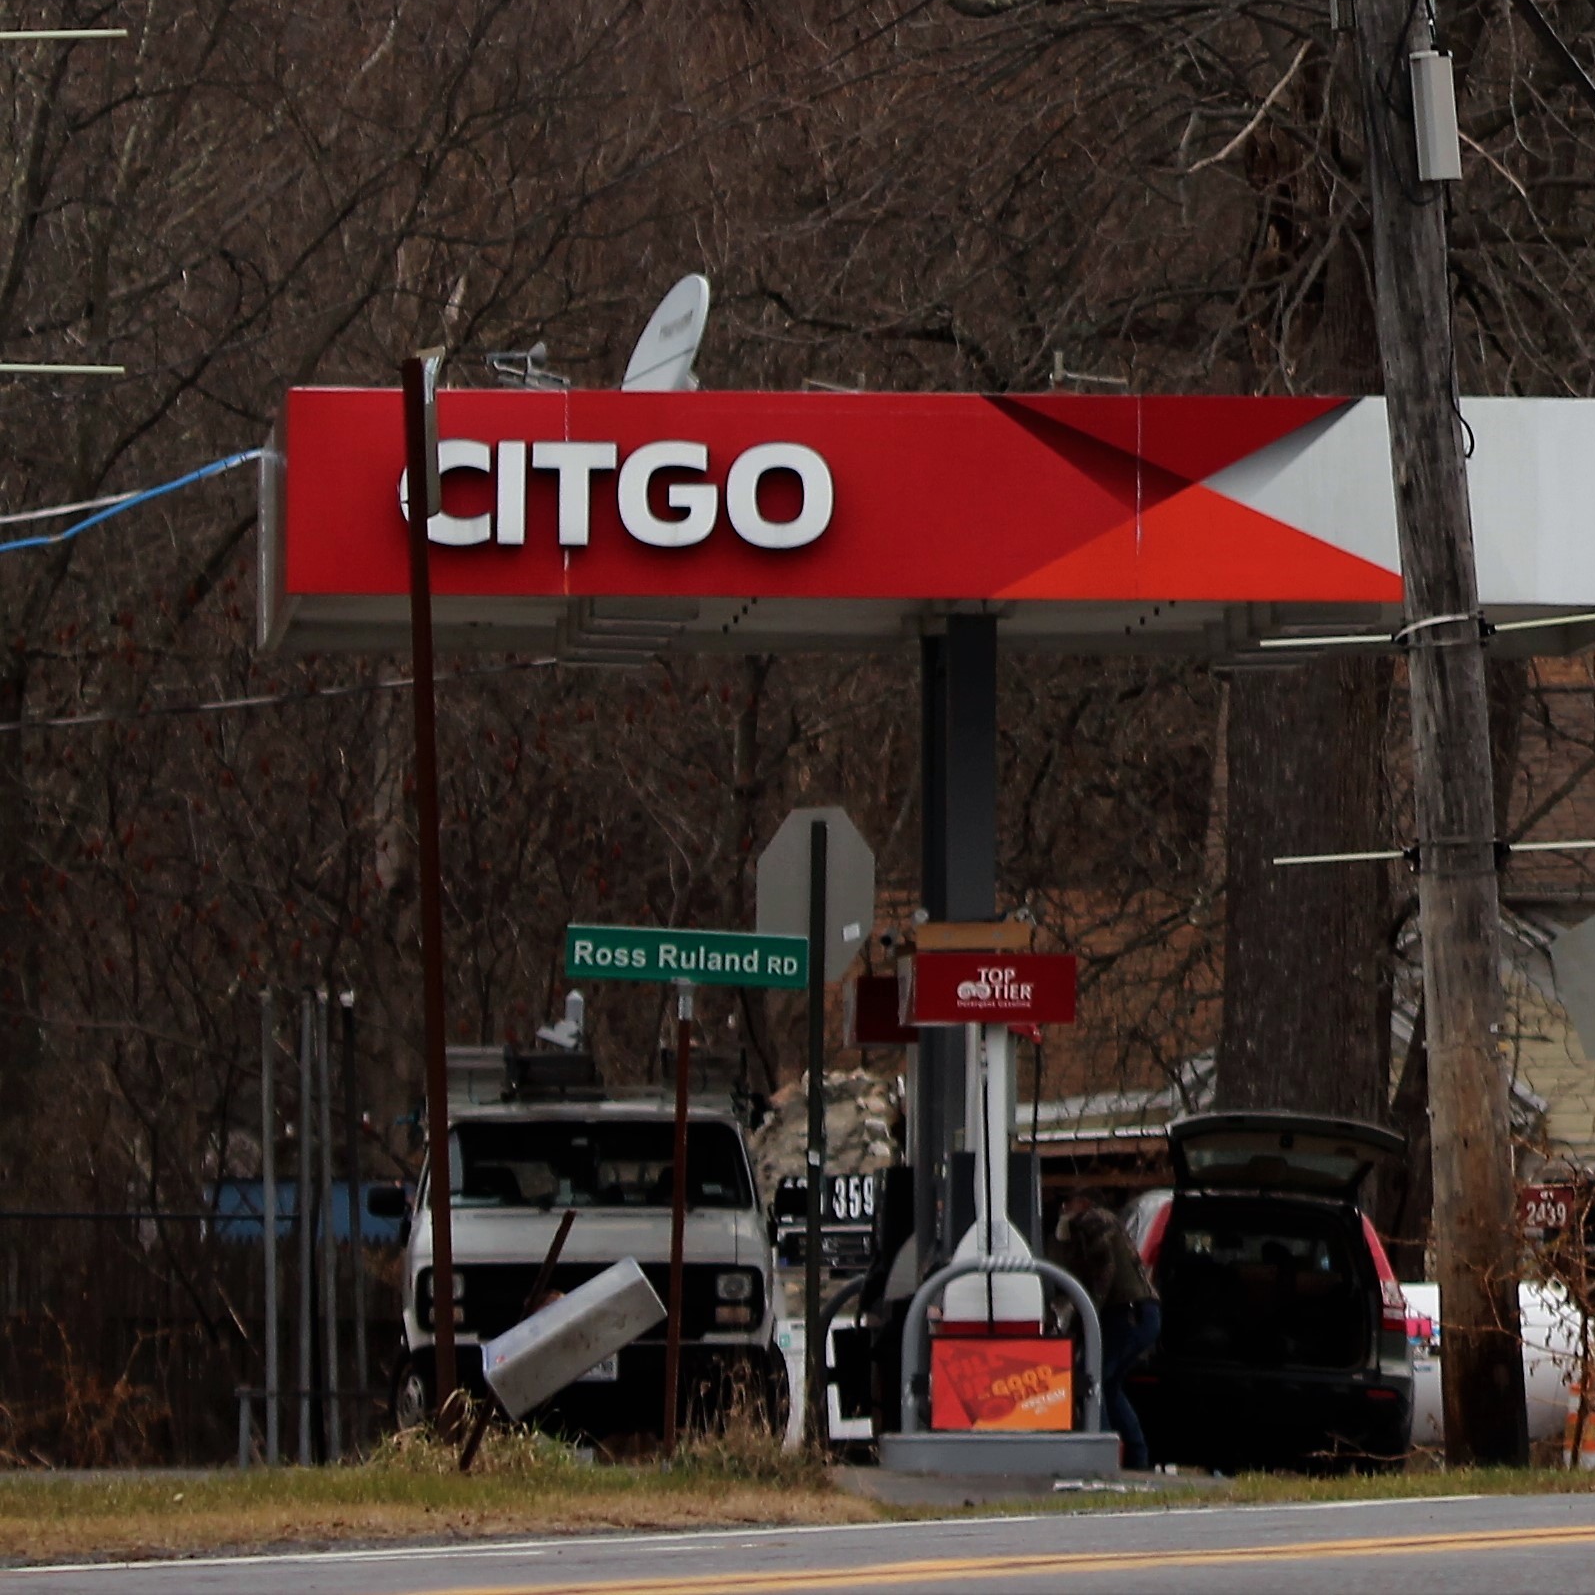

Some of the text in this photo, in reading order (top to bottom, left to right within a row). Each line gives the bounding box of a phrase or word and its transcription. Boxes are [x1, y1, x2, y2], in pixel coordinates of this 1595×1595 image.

[399, 438, 834, 549] CITGO
[574, 939, 798, 976] Ross Ruland RD
[977, 967, 1016, 985] TOP
[992, 982, 1032, 1000] TIER
